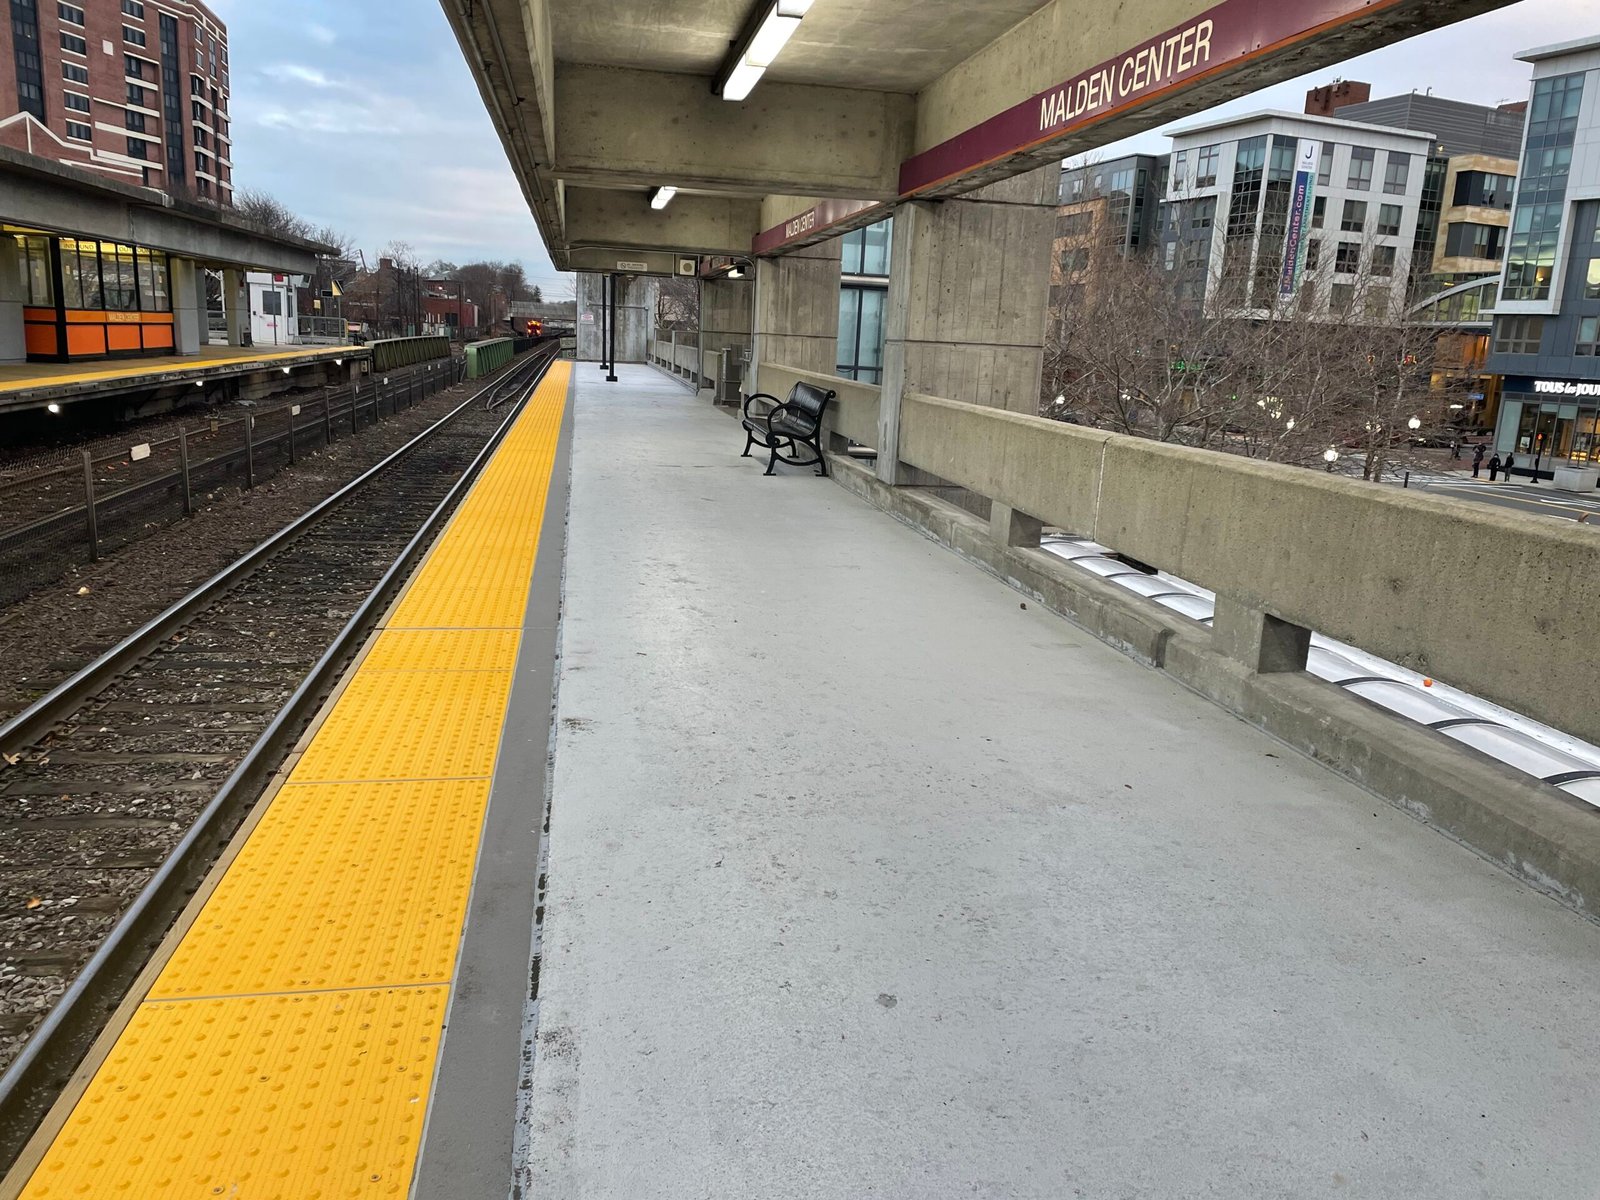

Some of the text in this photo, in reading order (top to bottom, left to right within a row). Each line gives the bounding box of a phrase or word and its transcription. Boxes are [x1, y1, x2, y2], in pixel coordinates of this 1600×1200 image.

[1039, 19, 1214, 131] MALDEN CENTER
[1305, 145, 1313, 159] J
[785, 211, 815, 239] MALDEN CENTER
[1283, 185, 1305, 290] JMaldenCenter.com
[1534, 380, 1564, 393] TOUS
[1564, 382, 1577, 394] les
